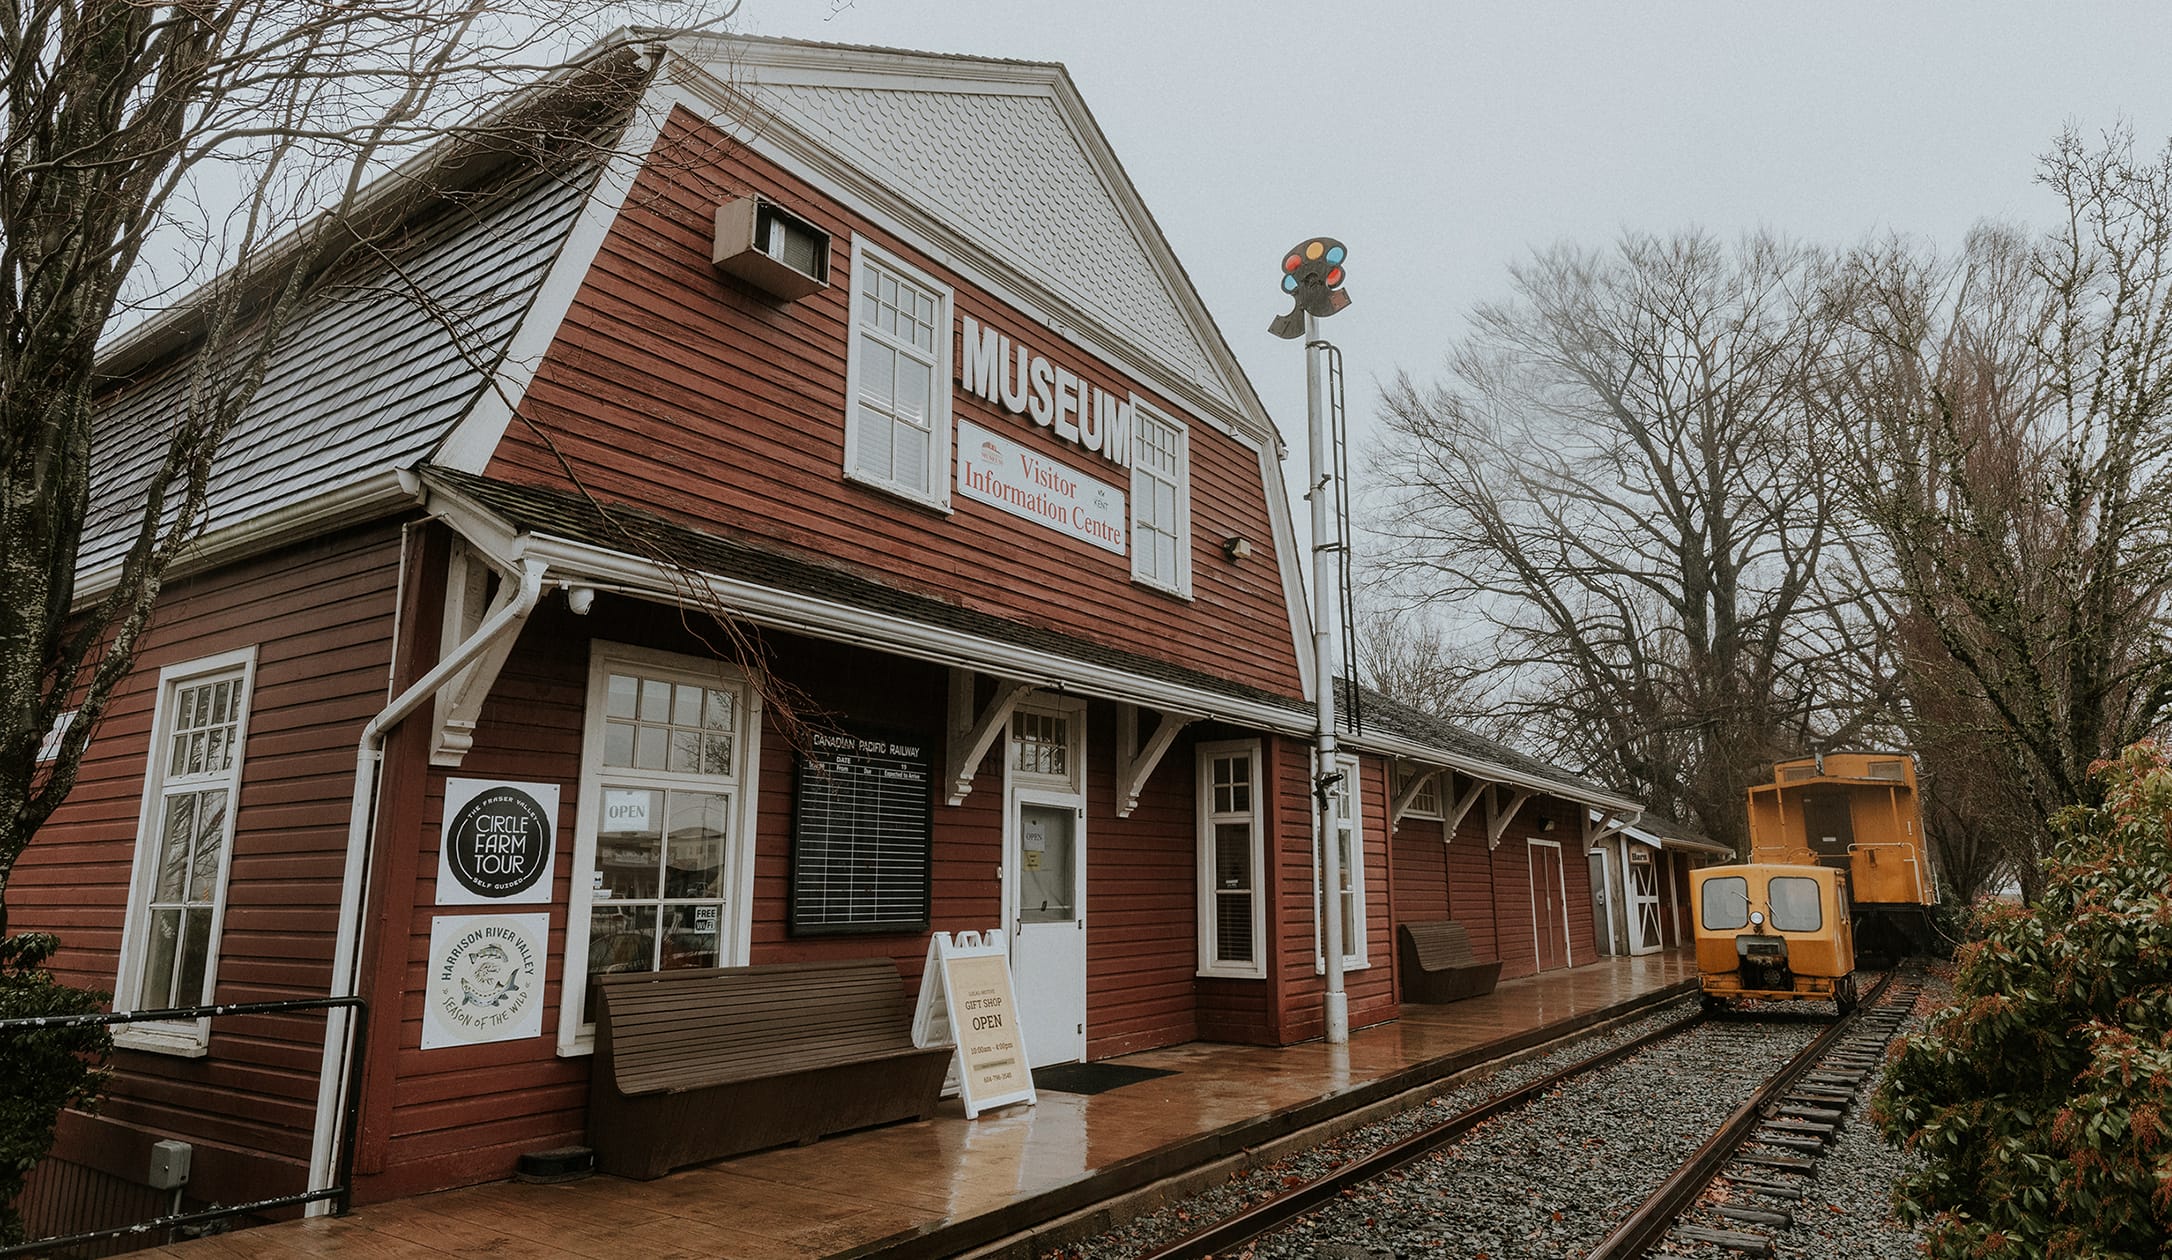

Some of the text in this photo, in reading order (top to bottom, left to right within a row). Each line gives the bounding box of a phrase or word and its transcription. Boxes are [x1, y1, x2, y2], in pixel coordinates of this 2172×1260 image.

[962, 315, 1131, 469] MUSEUM
[1019, 453, 1077, 499] Visitor
[965, 460, 1121, 545] Information Centre
[813, 734, 920, 758] CANADIAN PACIFIC RAILWAY
[836, 756, 851, 764] DATE
[836, 764, 849, 772] From
[863, 767, 872, 775] Due
[884, 769, 903, 779] Expected
[467, 796, 538, 820] THE FRASER VALLEY
[609, 805, 646, 819] OPEN
[475, 814, 529, 834] CIRCLE
[474, 833, 527, 854] FARM
[1025, 832, 1042, 841] OPEN
[474, 854, 524, 874] TOUR
[472, 877, 523, 890] SELF GUIDED
[696, 909, 716, 918] FREE
[441, 927, 535, 981] HARRISON RIVER VALLEY
[443, 991, 528, 1030] SEASON OF THE WILD
[965, 997, 1002, 1010] GIFT SHOP
[972, 1014, 1002, 1031] OPEN
